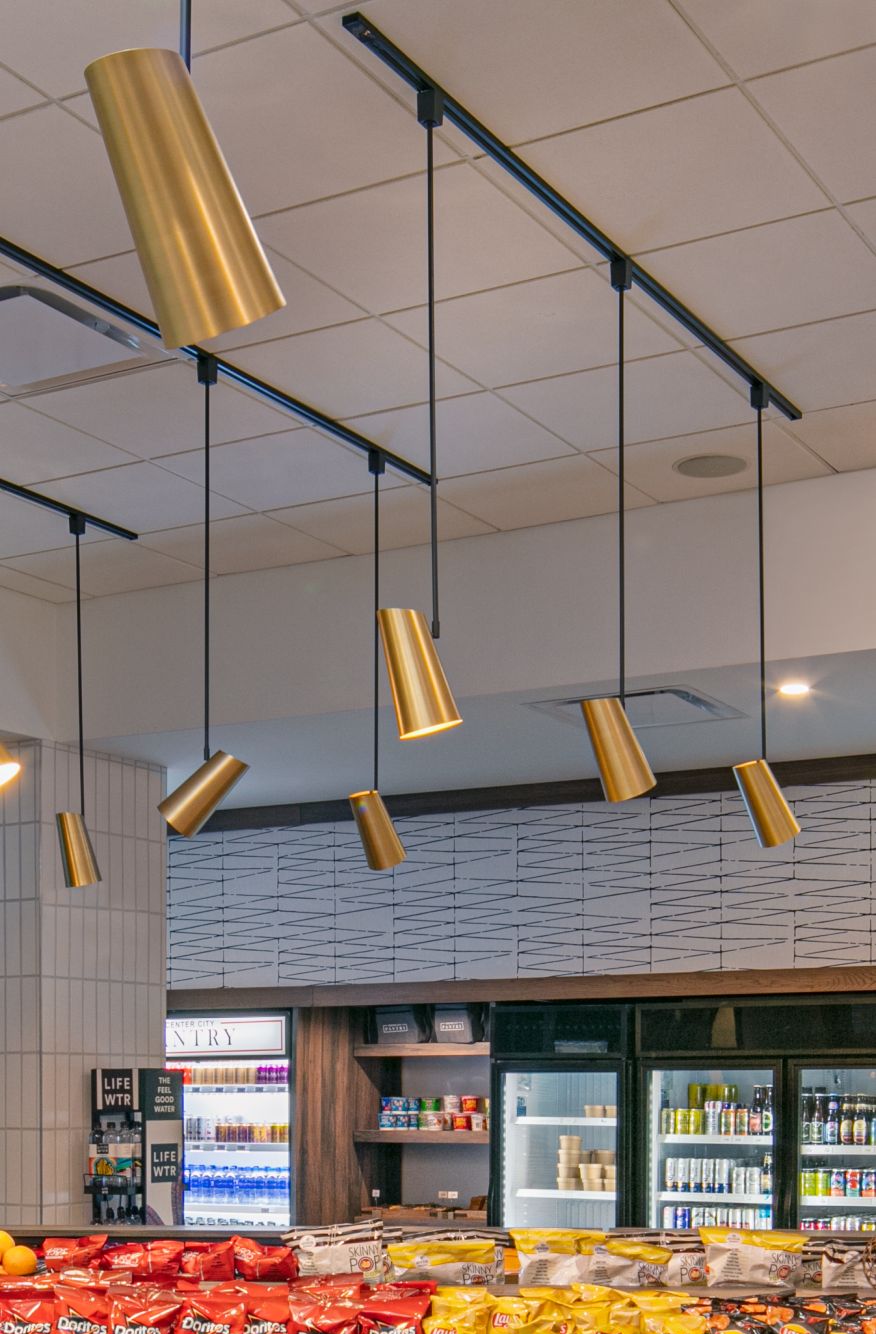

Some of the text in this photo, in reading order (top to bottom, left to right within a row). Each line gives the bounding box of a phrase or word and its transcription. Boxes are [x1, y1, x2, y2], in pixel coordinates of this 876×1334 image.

[197, 1020, 215, 1028] CITY
[166, 1028, 235, 1047] NTRY
[104, 1077, 131, 1090] LIFE
[158, 1077, 171, 1085] THE
[157, 1086, 172, 1094] FEEL
[104, 1093, 131, 1106] WTR
[153, 1105, 176, 1113] WATER
[153, 1151, 176, 1163] LIFE
[153, 1165, 176, 1177] WTR
[348, 1244, 379, 1257] SKINNY
[349, 1255, 381, 1272] POP
[462, 1263, 492, 1274] SKINNY
[802, 1262, 822, 1272] SKIN
[680, 1267, 705, 1283] PO
[803, 1271, 822, 1284] PO
[181, 1316, 231, 1334] Doritos
